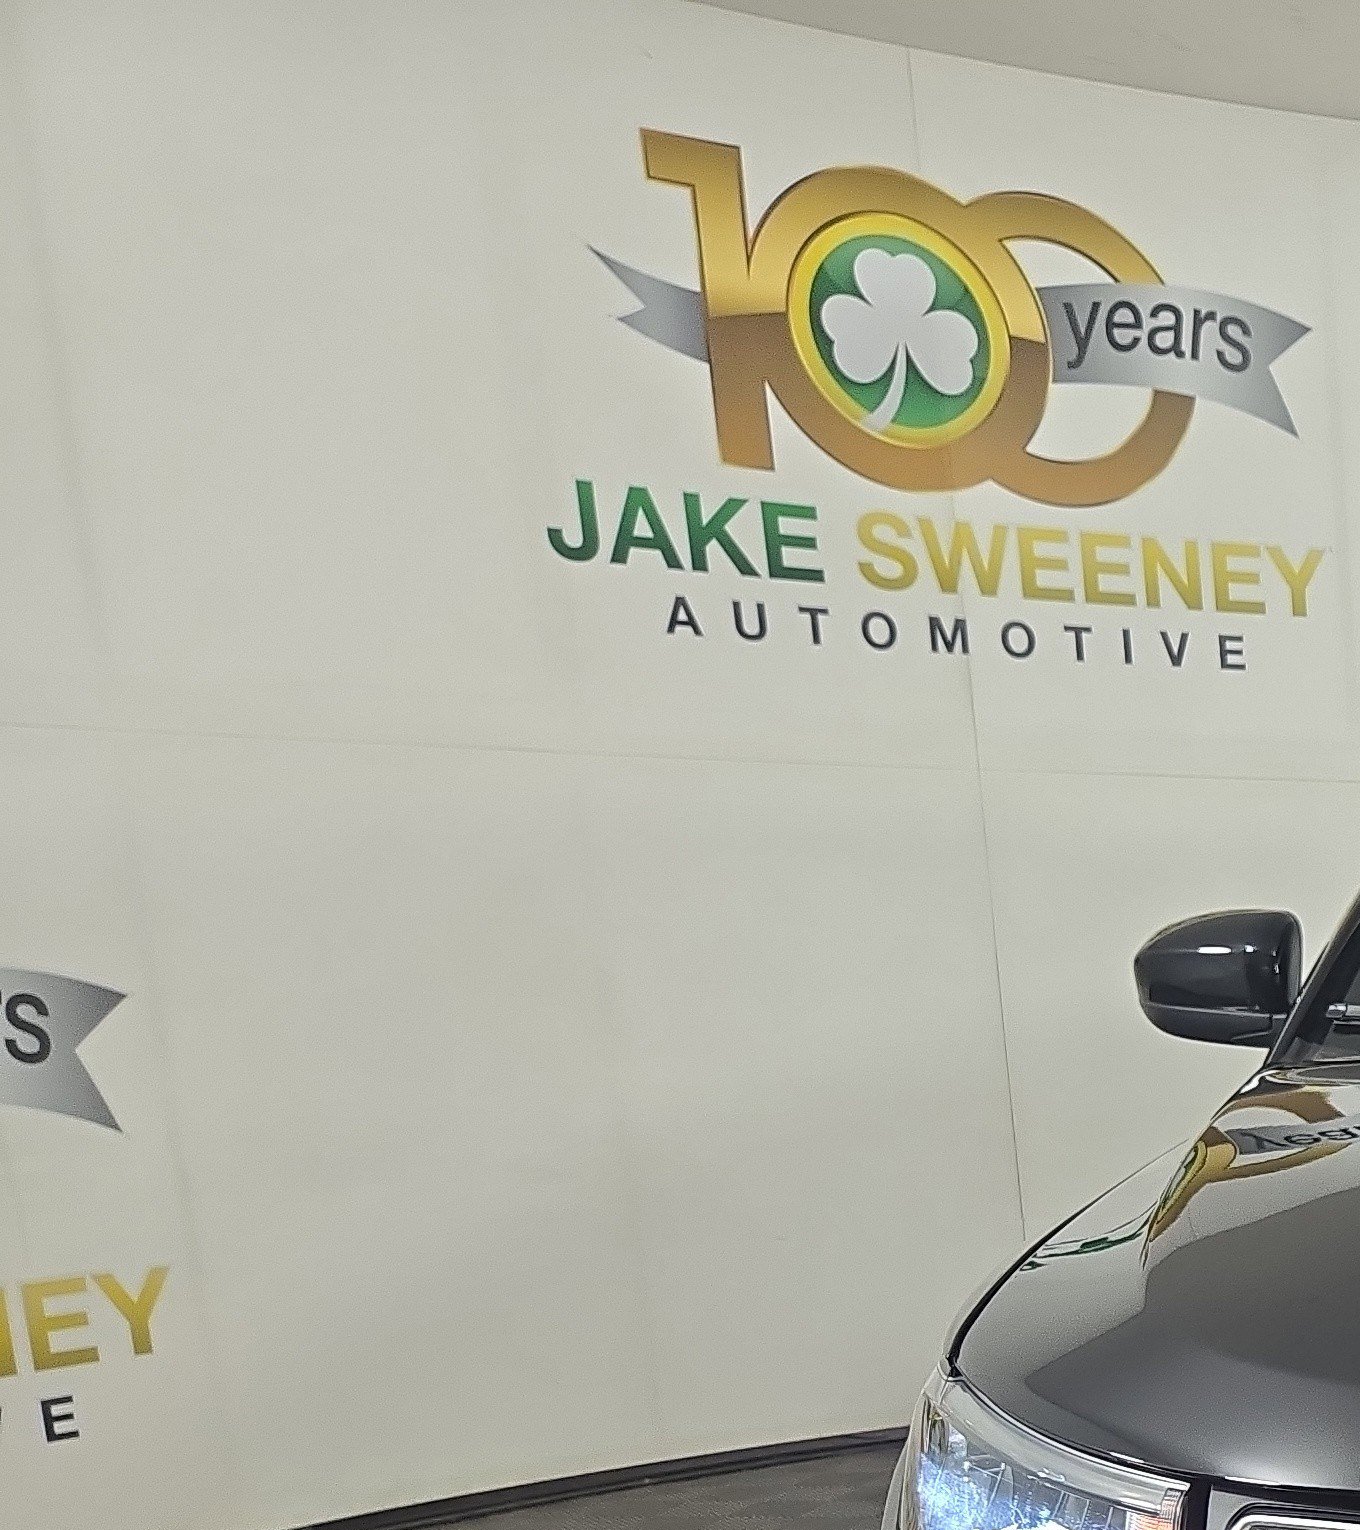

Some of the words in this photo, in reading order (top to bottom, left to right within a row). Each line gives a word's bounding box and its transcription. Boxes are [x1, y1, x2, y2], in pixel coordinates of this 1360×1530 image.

[1062, 294, 1254, 374] years
[546, 479, 826, 584] JAKE
[856, 511, 1325, 618] SWEENEY
[666, 596, 1248, 671] AUTOMOTIVE
